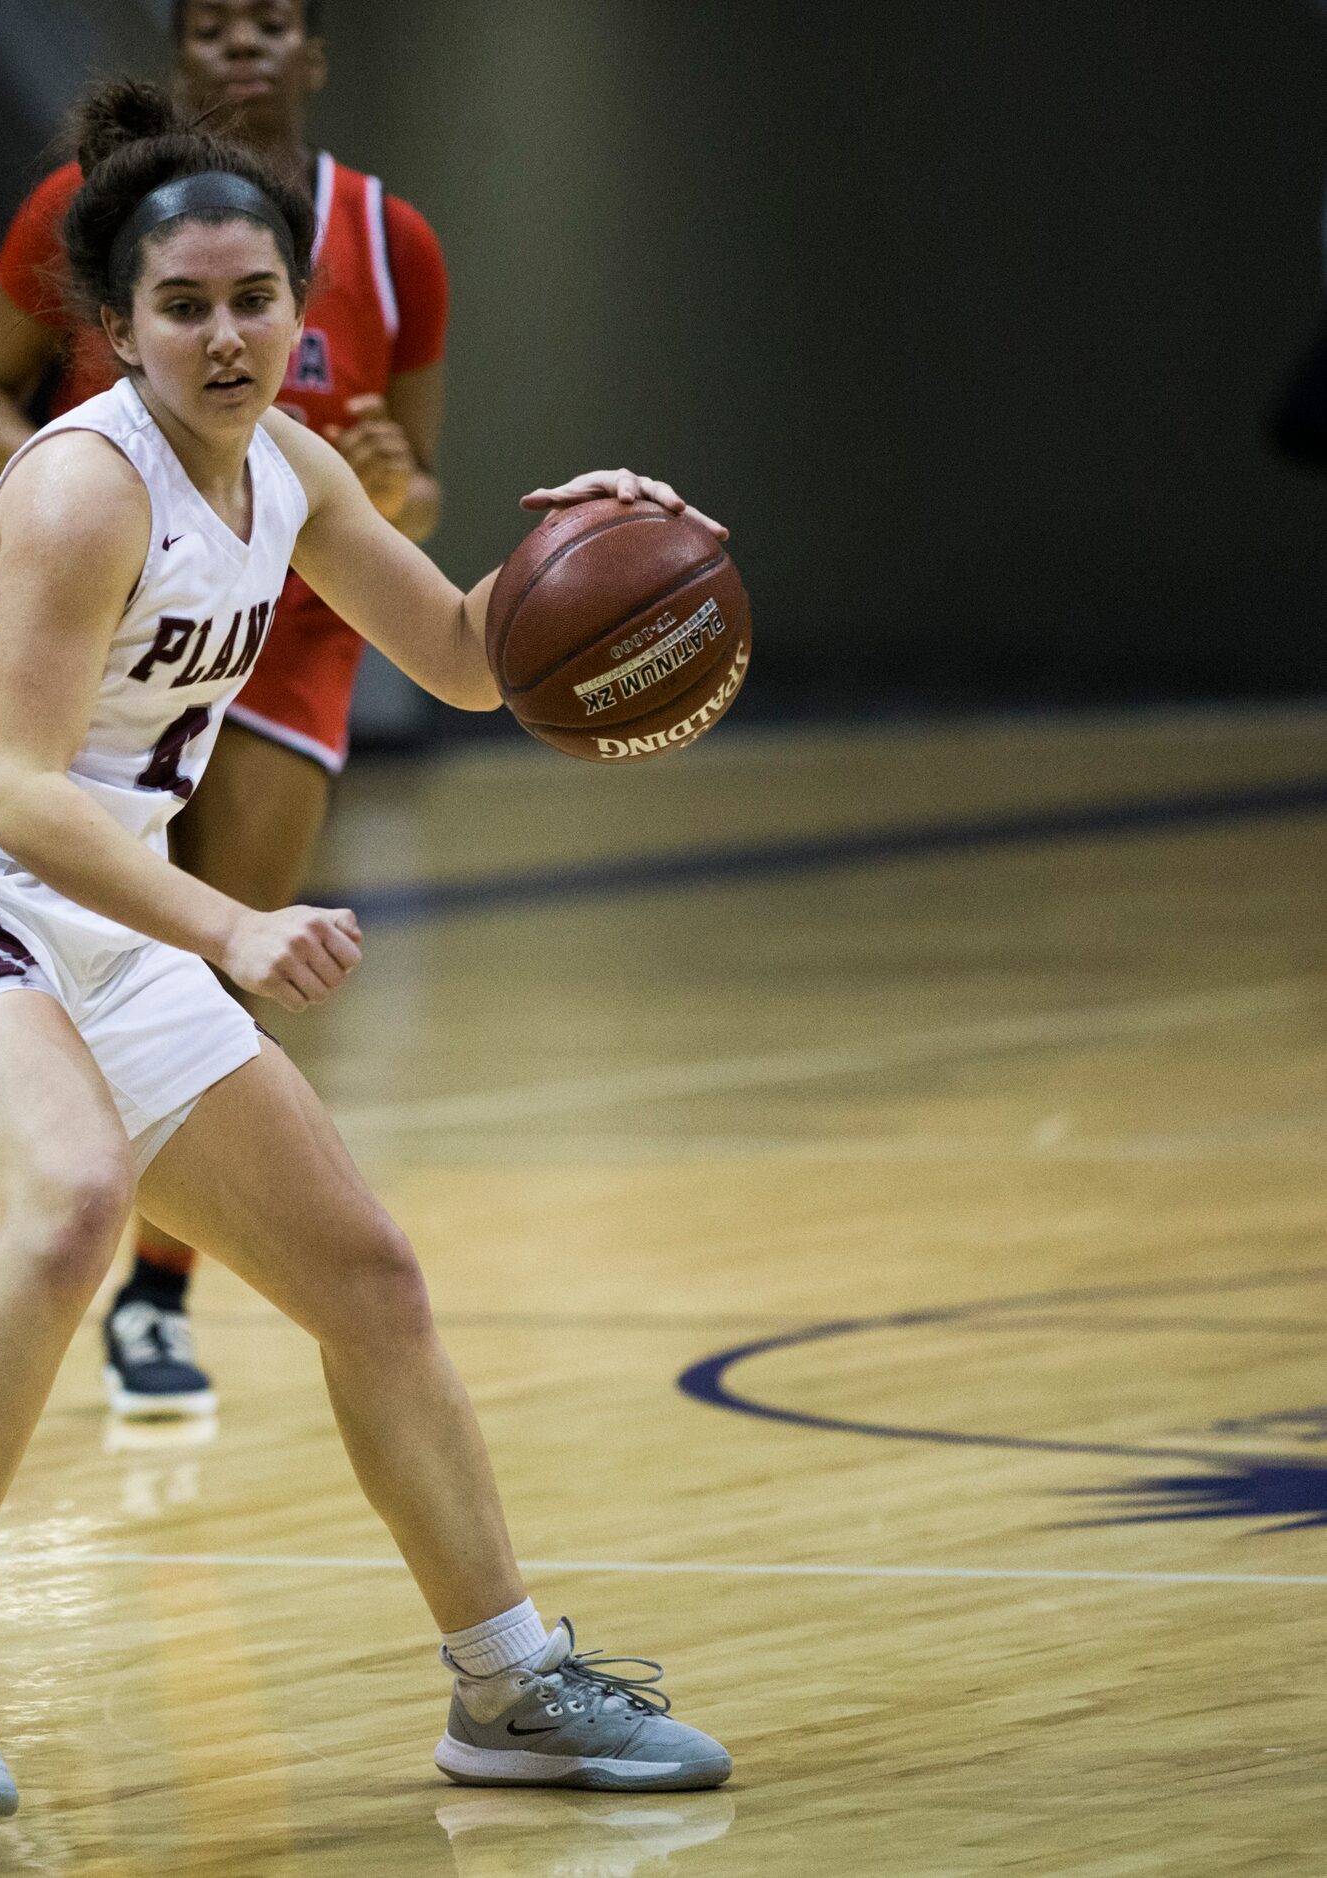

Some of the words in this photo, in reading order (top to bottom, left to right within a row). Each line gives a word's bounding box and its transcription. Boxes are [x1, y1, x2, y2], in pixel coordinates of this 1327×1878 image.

[127, 595, 280, 689] PLAN
[618, 607, 726, 699] PLATINUM
[596, 640, 749, 759] SPALDING
